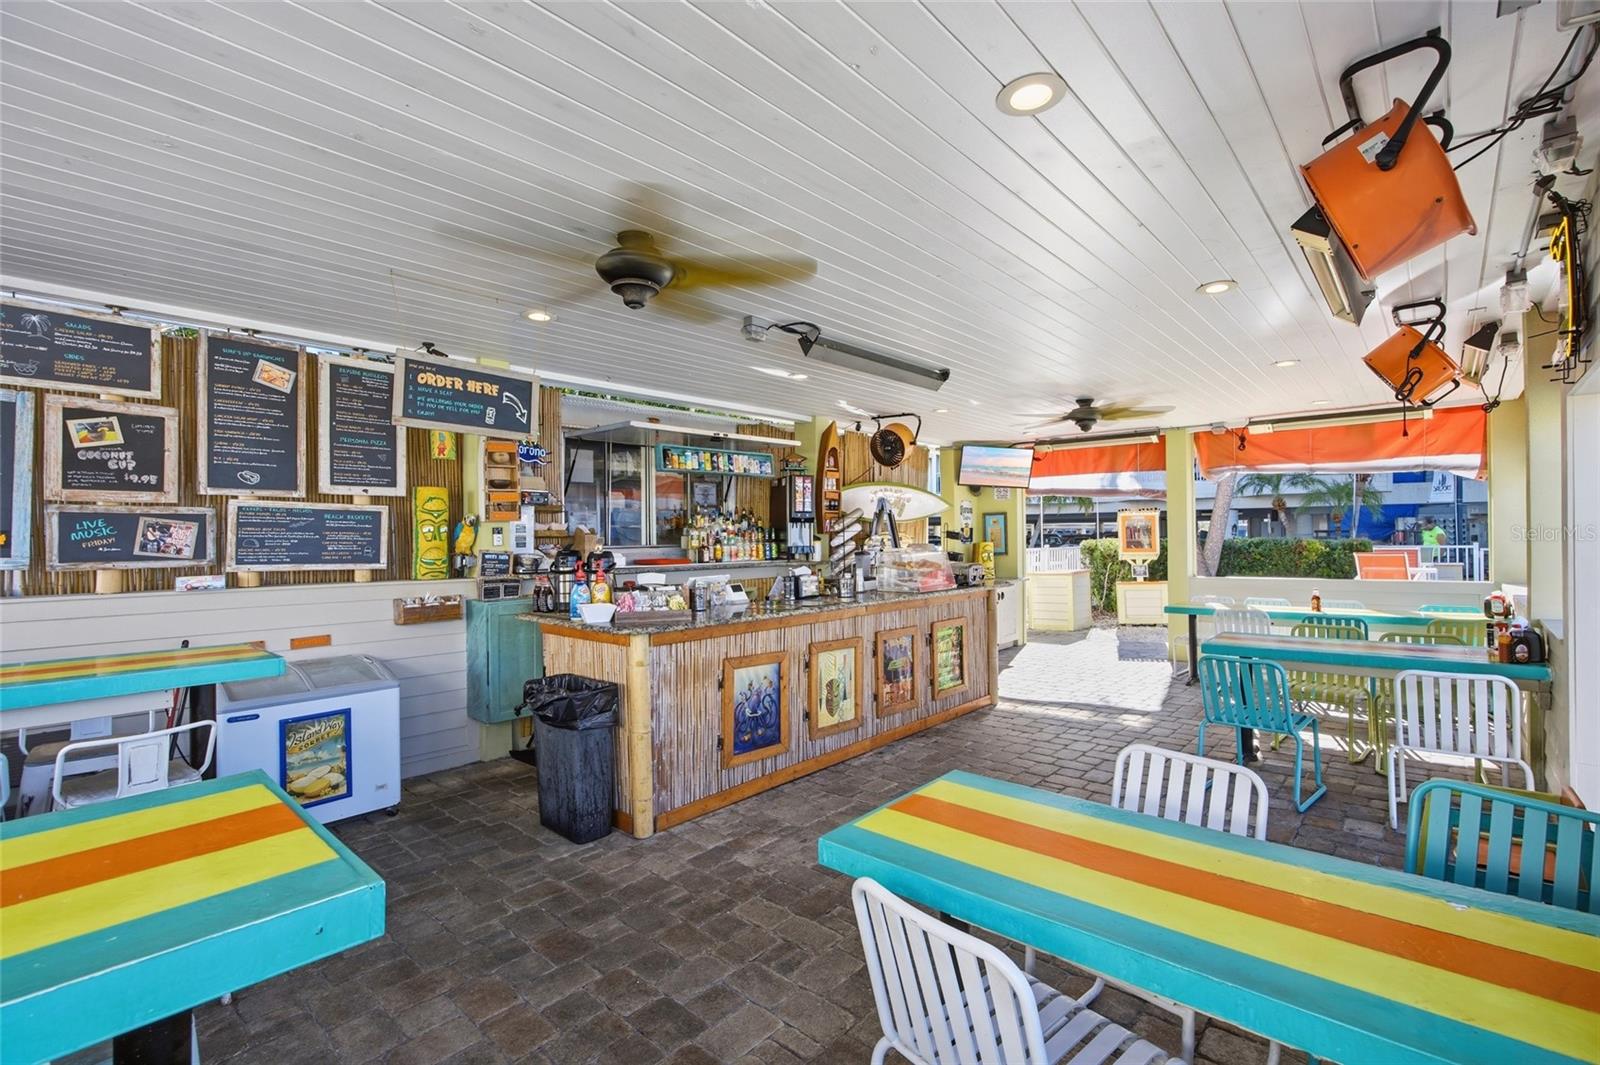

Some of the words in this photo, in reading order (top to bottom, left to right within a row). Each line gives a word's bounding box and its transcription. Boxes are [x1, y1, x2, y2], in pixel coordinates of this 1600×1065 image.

[64, 321, 92, 330] SALADS
[416, 372, 464, 391] ORDER
[466, 379, 500, 397] HERE
[417, 386, 433, 394] HAVE
[339, 436, 369, 445] PERSONAL
[77, 449, 134, 460] COCONUT
[107, 459, 137, 471] CUP
[124, 472, 158, 485] $9.95
[76, 518, 106, 530] LIVE
[70, 526, 118, 541] MUSIC
[81, 538, 116, 549] FRIDAY!
[288, 724, 322, 751] Island
[323, 719, 344, 734] Way
[298, 732, 332, 752] SORBET
